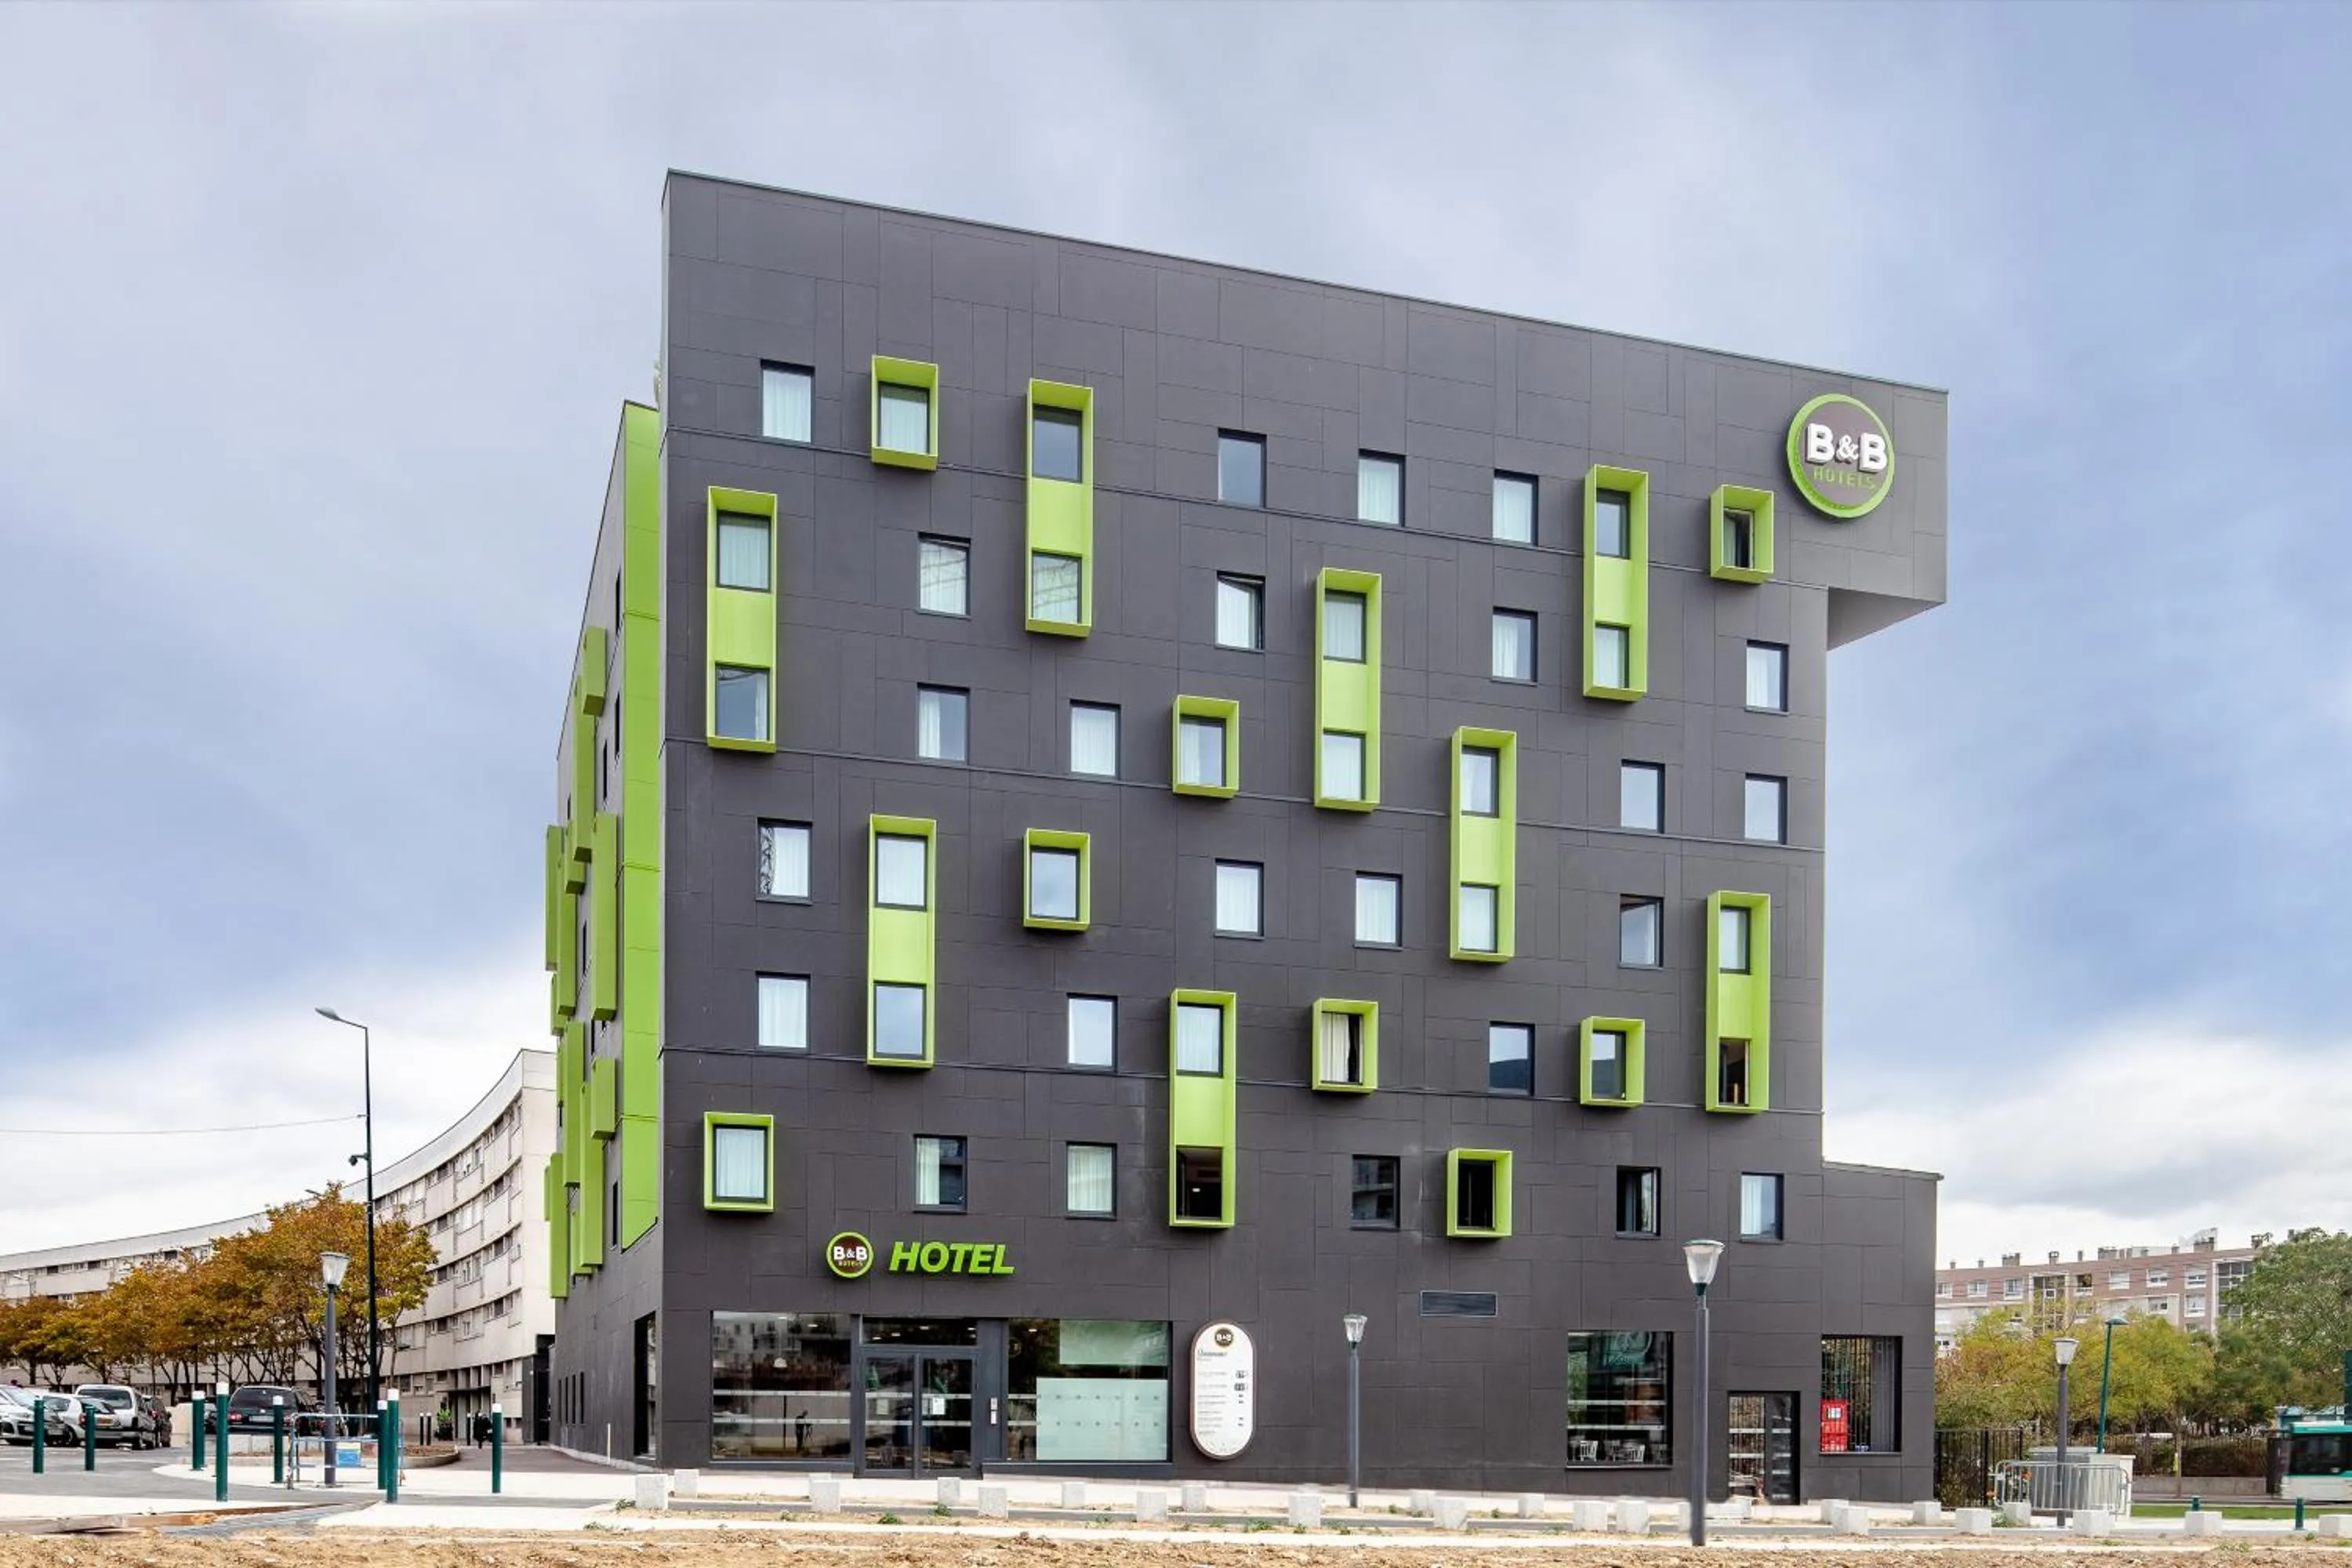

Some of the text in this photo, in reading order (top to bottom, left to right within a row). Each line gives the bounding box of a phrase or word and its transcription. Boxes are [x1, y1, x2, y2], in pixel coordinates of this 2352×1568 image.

[1806, 423, 1888, 473] B&B
[1813, 466, 1876, 490] HOTELS
[833, 1246, 868, 1261] B&B
[888, 1241, 1015, 1275] HOTEL
